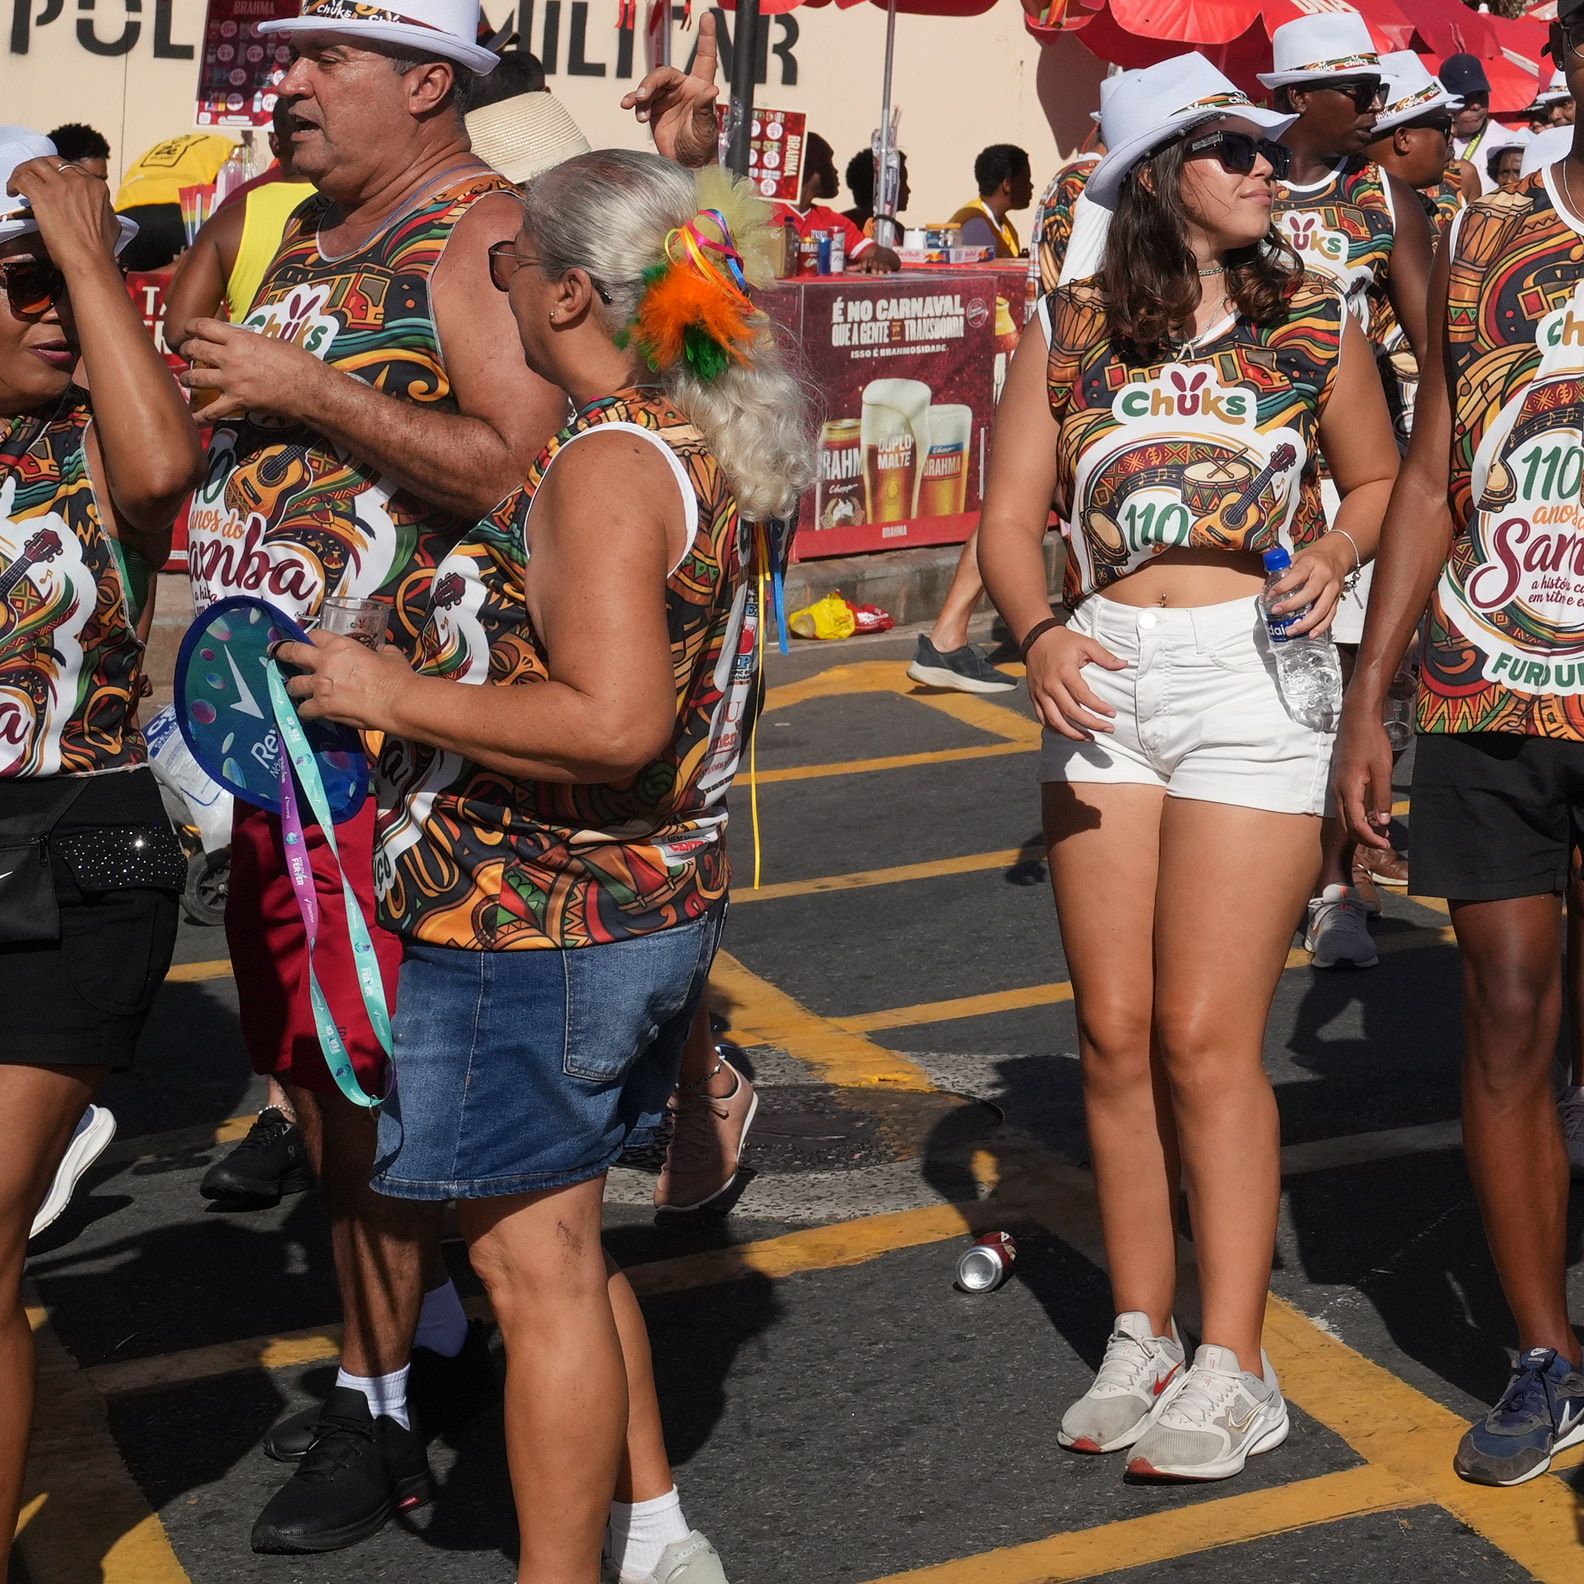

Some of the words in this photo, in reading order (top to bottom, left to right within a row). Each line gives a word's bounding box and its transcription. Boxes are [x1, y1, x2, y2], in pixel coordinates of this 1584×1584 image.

[233, 1, 275, 15] BRAHMA
[784, 134, 801, 178] BRAHMA
[832, 296, 846, 323] É
[847, 299, 873, 322] NO
[876, 295, 965, 321] CARNAVAL
[831, 322, 851, 347] QUE
[851, 322, 860, 345] A
[860, 321, 890, 345] GENTE
[851, 348, 872, 359] ISSO
[878, 434, 913, 453] DUPLO
[877, 450, 911, 470] MALTE
[1522, 444, 1583, 502] 110
[882, 525, 908, 539] BRAHMA
[1124, 502, 1189, 553] 110
[190, 513, 319, 601] amba
[1531, 580, 1539, 590] a
[1528, 592, 1544, 603] em
[1567, 596, 1574, 606] e
